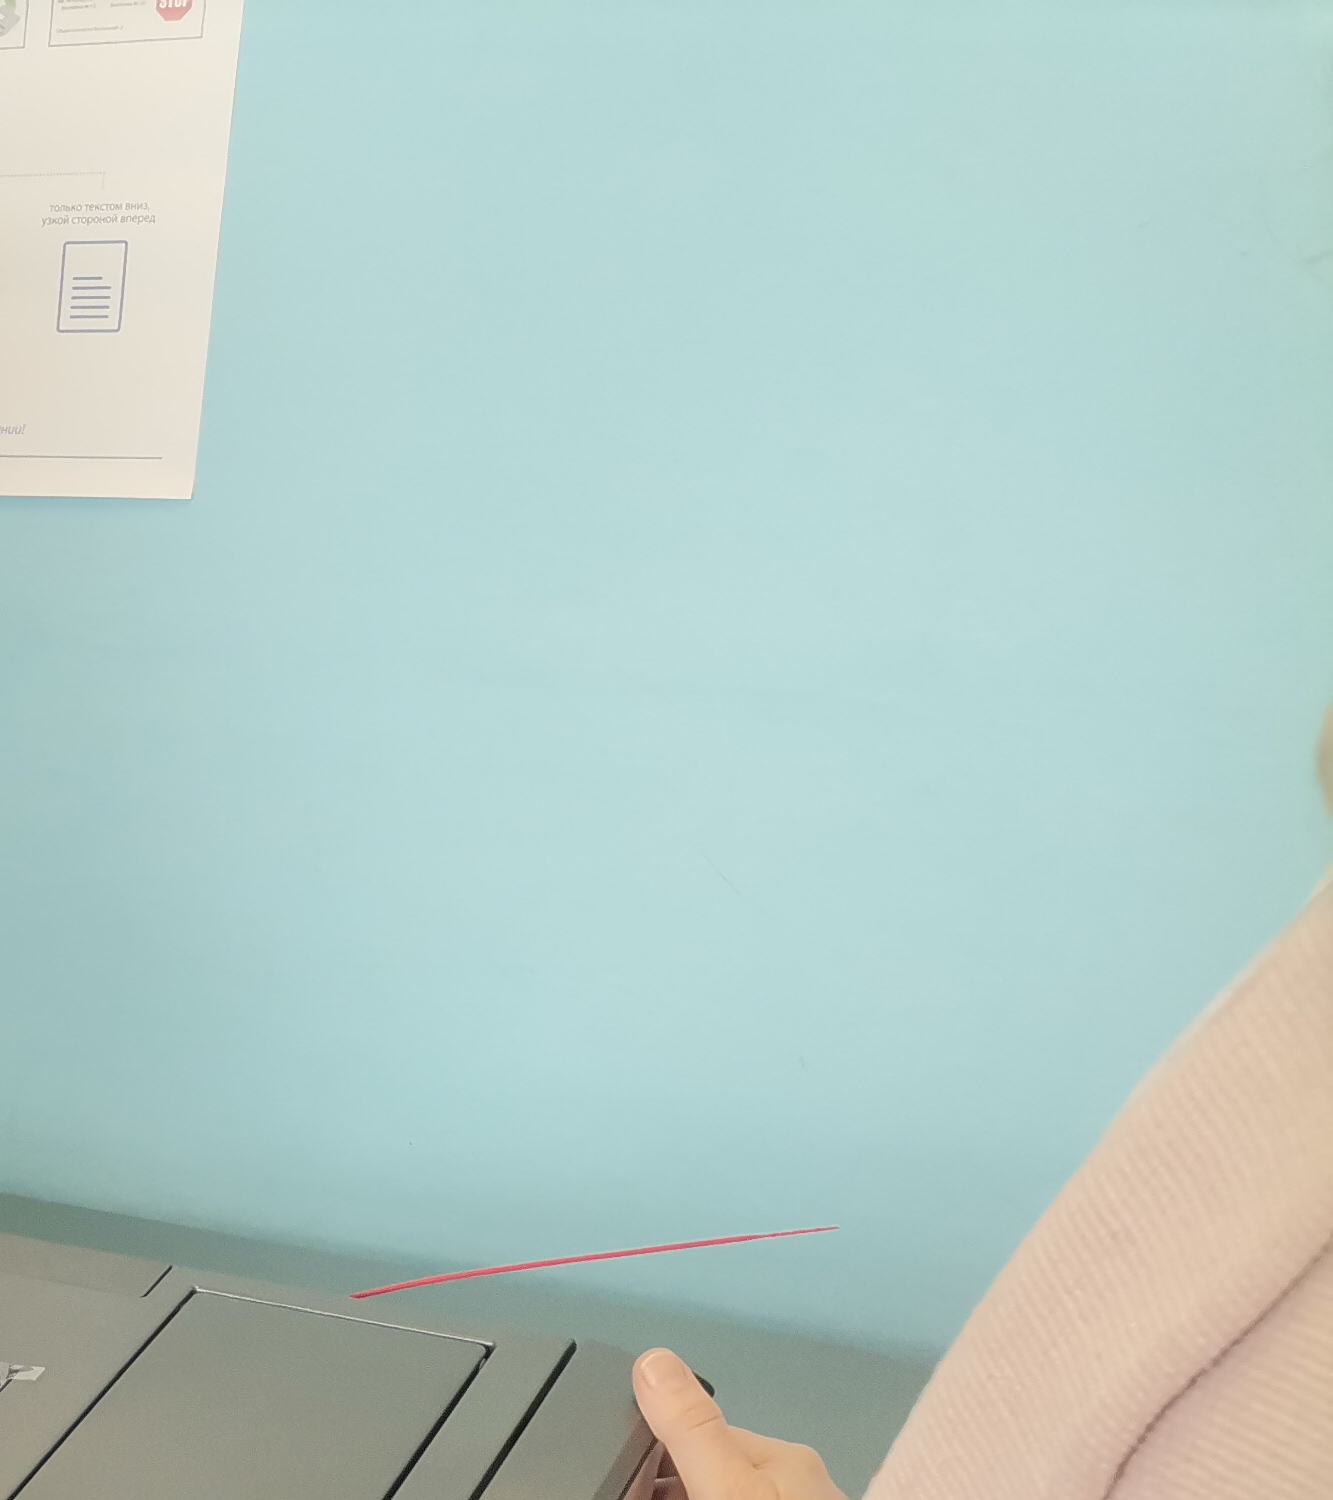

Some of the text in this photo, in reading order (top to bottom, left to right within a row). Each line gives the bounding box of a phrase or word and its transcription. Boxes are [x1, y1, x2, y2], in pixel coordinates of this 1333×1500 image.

[41, 214, 156, 228] узкой стороной вперед
